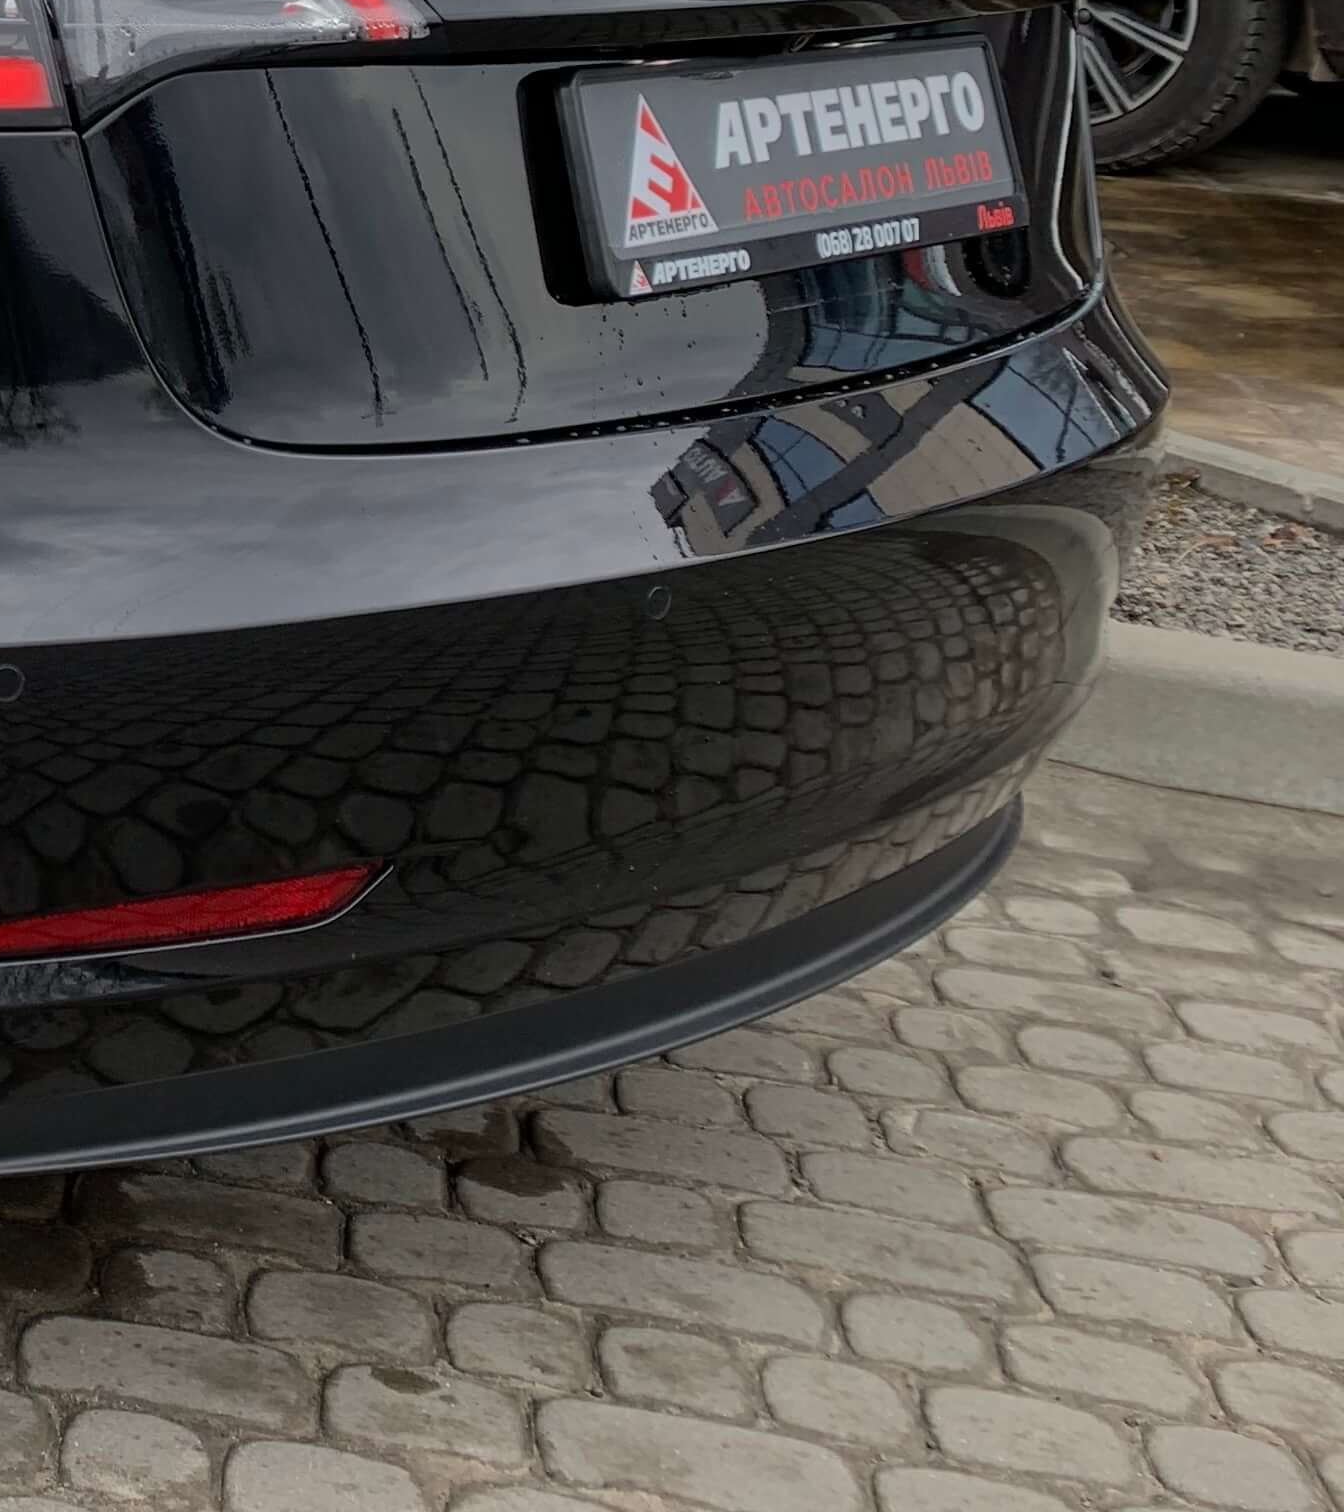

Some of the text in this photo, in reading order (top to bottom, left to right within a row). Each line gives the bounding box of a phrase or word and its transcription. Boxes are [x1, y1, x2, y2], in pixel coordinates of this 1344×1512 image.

[715, 71, 985, 169] АРТЕНЕРГО
[744, 150, 993, 222] АВТОСАЛОН ЛЬВІВ
[628, 212, 710, 242] АРТЕНЕРГО
[817, 217, 921, 259] (068) 28 007 07
[651, 249, 752, 286] АРТЕНЕРГО
